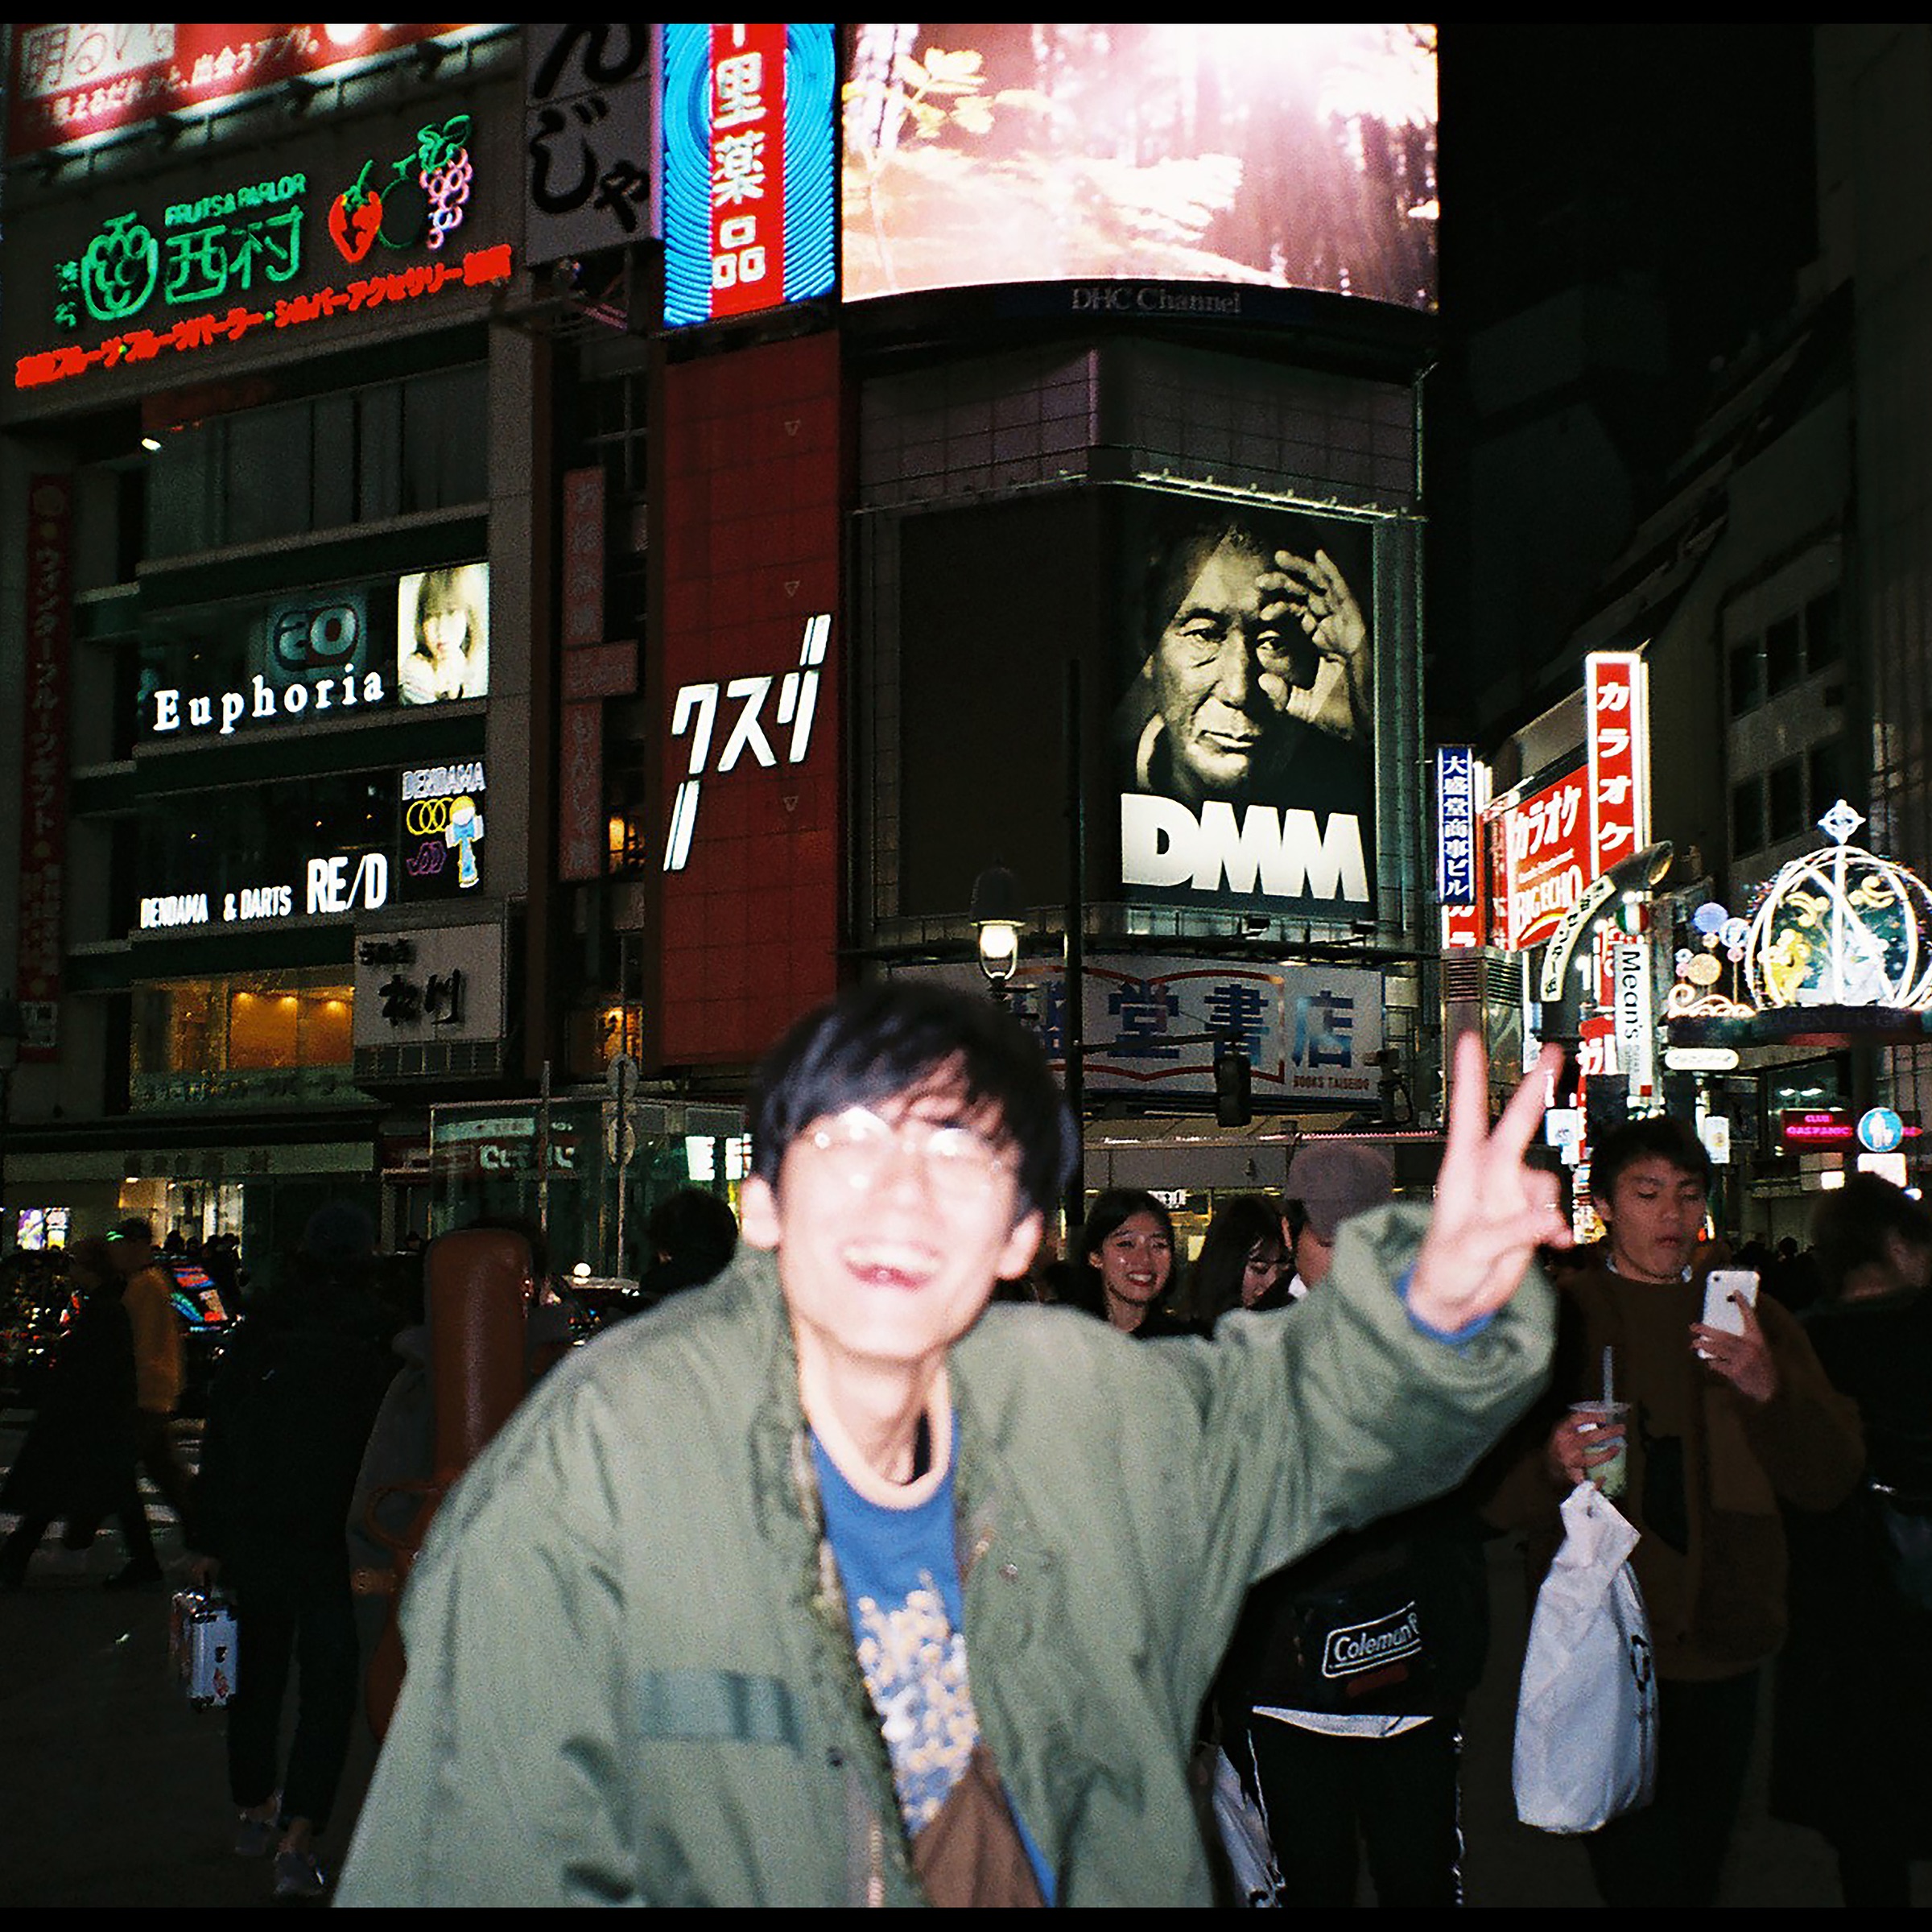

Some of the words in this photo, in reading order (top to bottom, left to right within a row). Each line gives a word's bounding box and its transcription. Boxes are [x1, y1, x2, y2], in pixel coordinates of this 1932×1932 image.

[165, 205, 304, 304] 西村
[1071, 287, 1131, 311] DHC
[1137, 287, 1241, 314] Channel
[153, 663, 385, 734] Euphoria
[1596, 681, 1633, 852] カラオケ
[1121, 792, 1370, 902] DMM
[1511, 785, 1582, 860] カラオケ
[222, 893, 237, 923] &
[240, 885, 292, 920] DARTS
[307, 853, 387, 914] RE/D
[1622, 950, 1643, 1040] Mean's
[1335, 1625, 1411, 1662] Coleman
